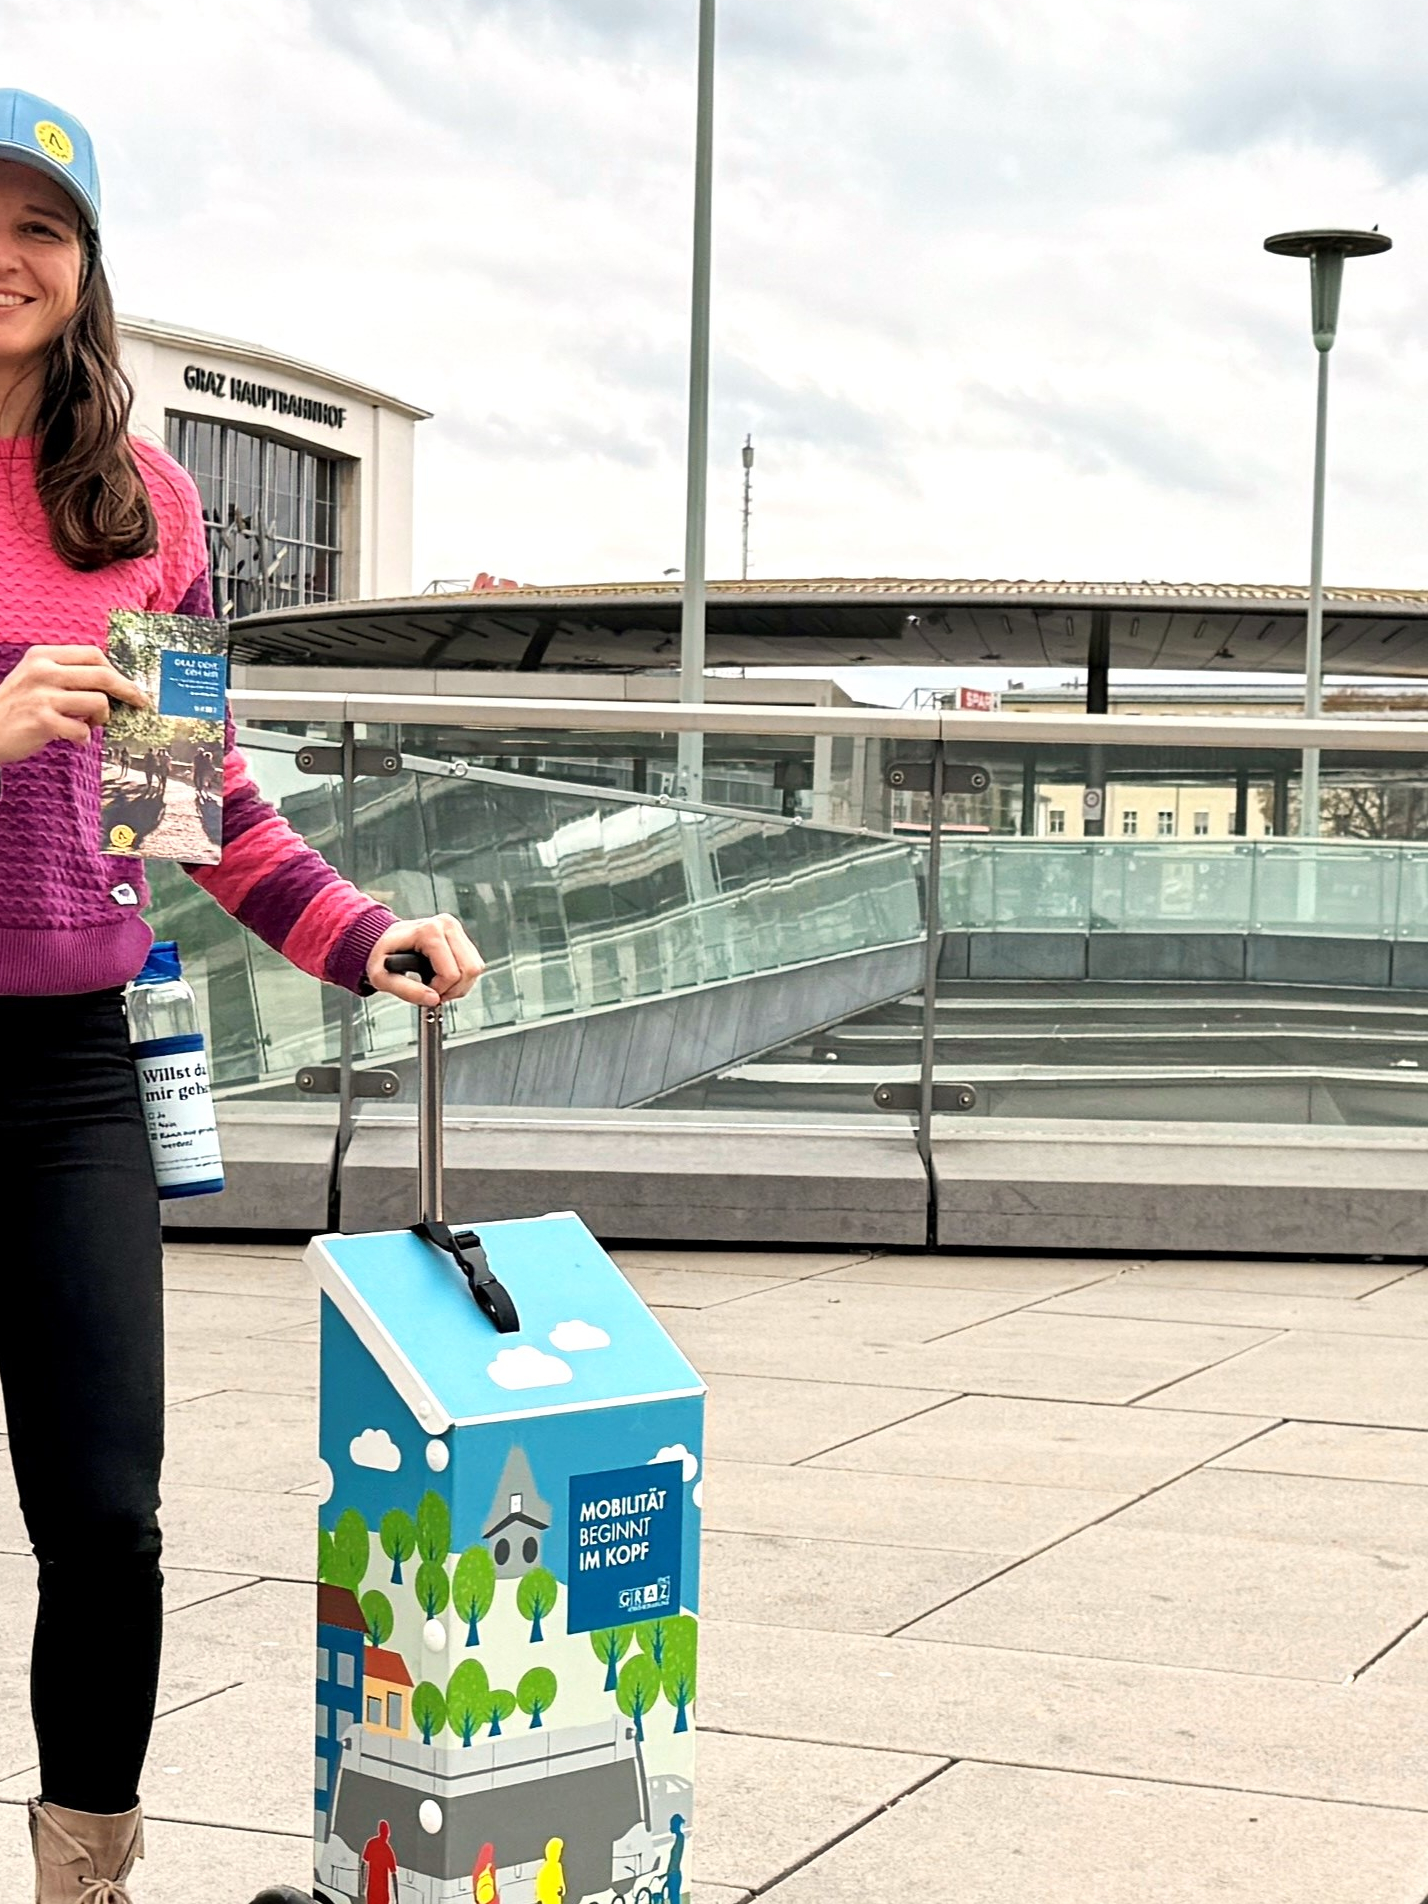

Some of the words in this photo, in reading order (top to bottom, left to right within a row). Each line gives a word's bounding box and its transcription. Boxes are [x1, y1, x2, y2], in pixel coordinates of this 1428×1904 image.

[184, 365, 226, 398] GRAZ
[230, 377, 348, 429] HAUPTBAHNHOF
[143, 1066, 191, 1083] Willst
[145, 1087, 174, 1102] mir
[579, 1487, 667, 1522] MOBILITÄT
[579, 1517, 652, 1547] BEGINNT
[579, 1550, 600, 1571] IM
[605, 1541, 650, 1567] KOPF
[619, 1584, 670, 1608] GRAZ
